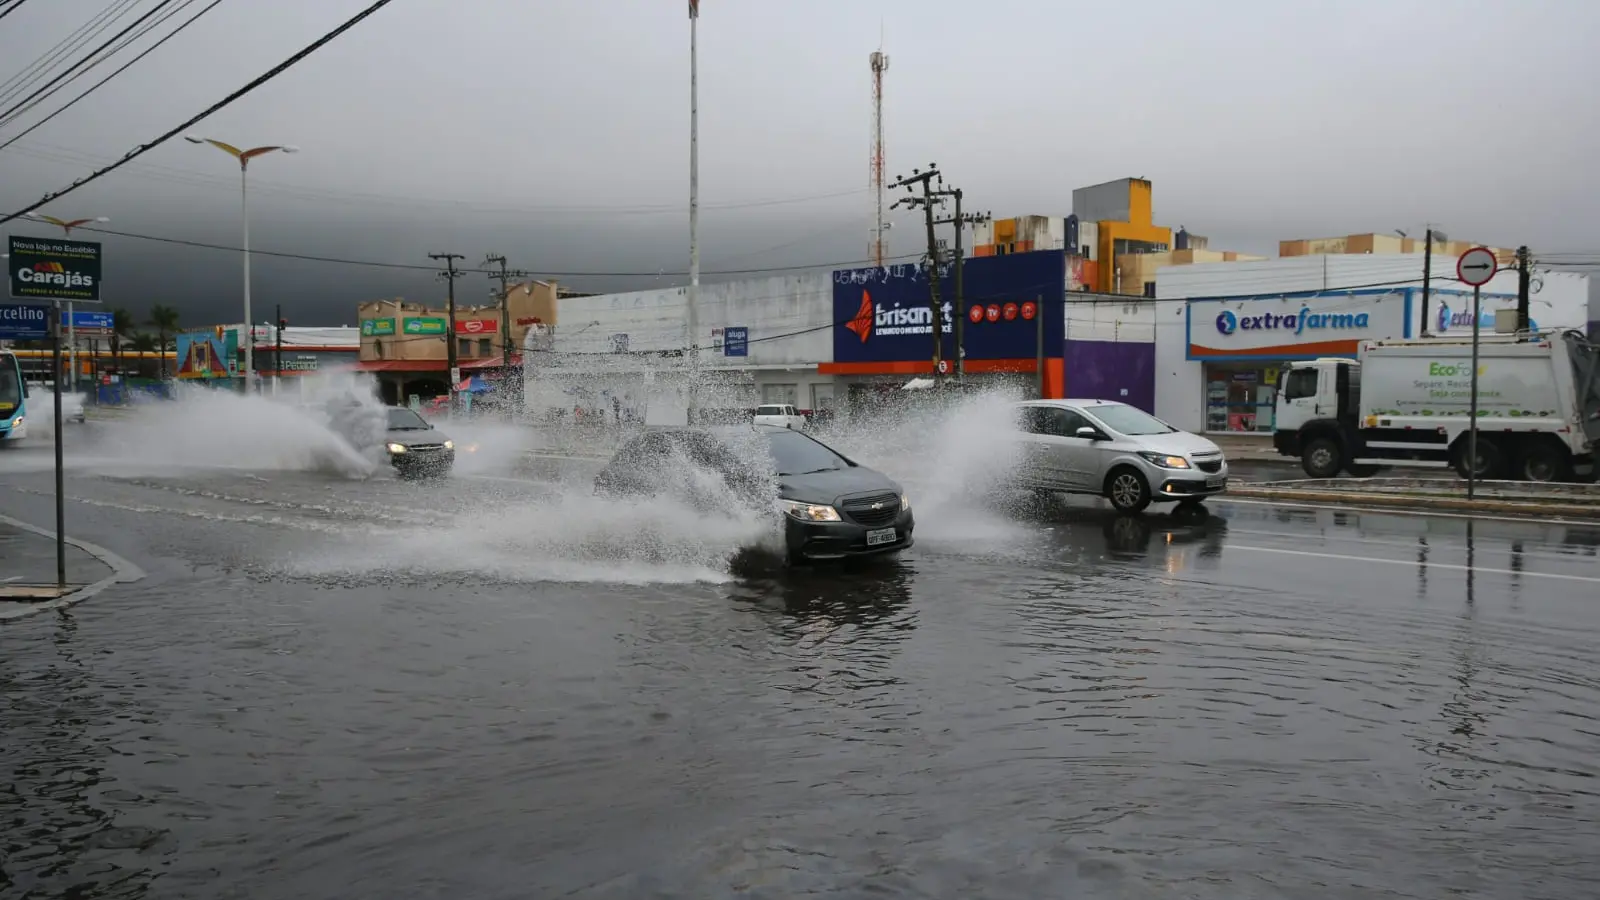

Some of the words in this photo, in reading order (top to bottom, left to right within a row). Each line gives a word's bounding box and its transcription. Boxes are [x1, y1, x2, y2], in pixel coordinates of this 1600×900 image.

[13, 241, 34, 249] Nova
[35, 243, 51, 252] loja
[18, 267, 93, 288] Carajás
[875, 301, 953, 326] brisant
[1240, 307, 1369, 336] extrafarma
[1430, 361, 1474, 376] EcoFo
